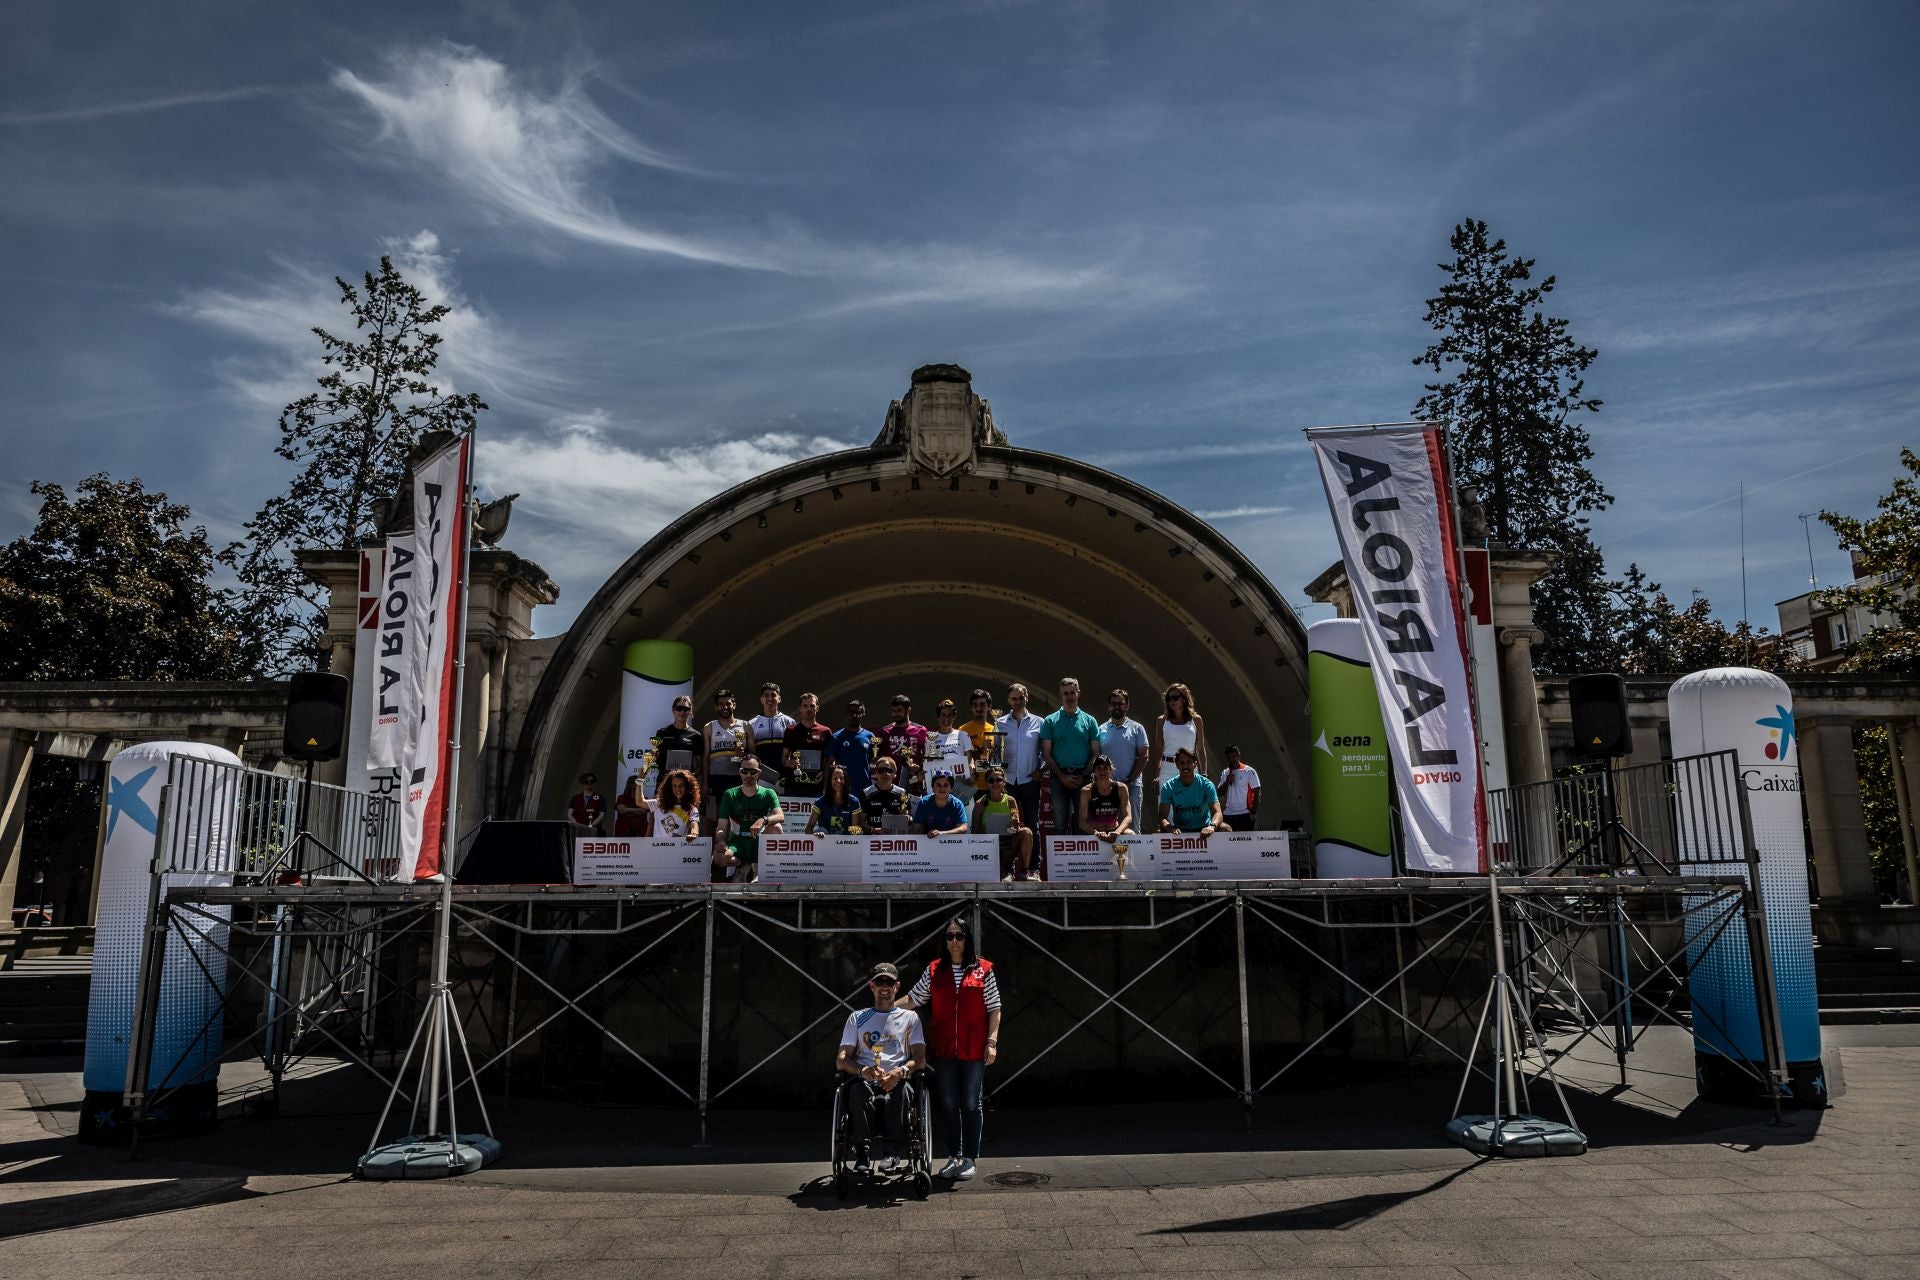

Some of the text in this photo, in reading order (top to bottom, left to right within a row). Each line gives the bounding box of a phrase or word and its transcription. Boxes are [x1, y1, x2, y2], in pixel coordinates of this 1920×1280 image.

[1333, 735, 1371, 747] aena
[1342, 763, 1371, 773] para ti
